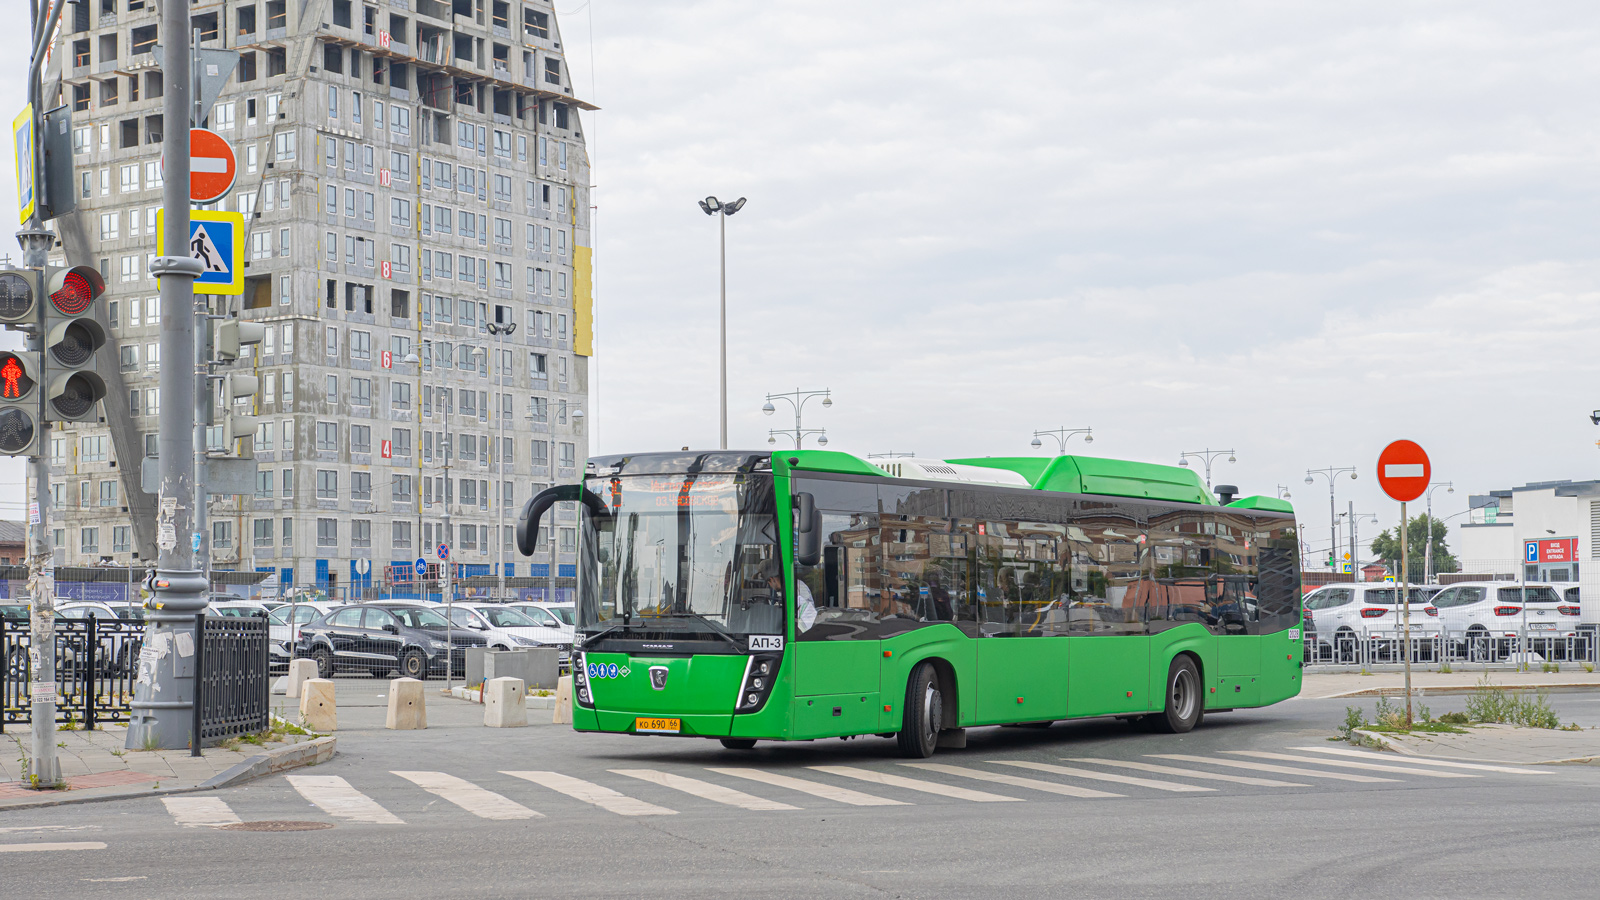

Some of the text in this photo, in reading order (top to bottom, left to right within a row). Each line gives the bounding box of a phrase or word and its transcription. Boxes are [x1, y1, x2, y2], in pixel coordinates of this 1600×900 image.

[380, 31, 389, 48] 13
[380, 169, 390, 186] 10
[383, 261, 390, 278] 8
[383, 351, 390, 368] 6
[383, 440, 390, 457] 4
[751, 638, 781, 649] АП-3
[651, 720, 666, 729] 690
[669, 719, 678, 727] 66
